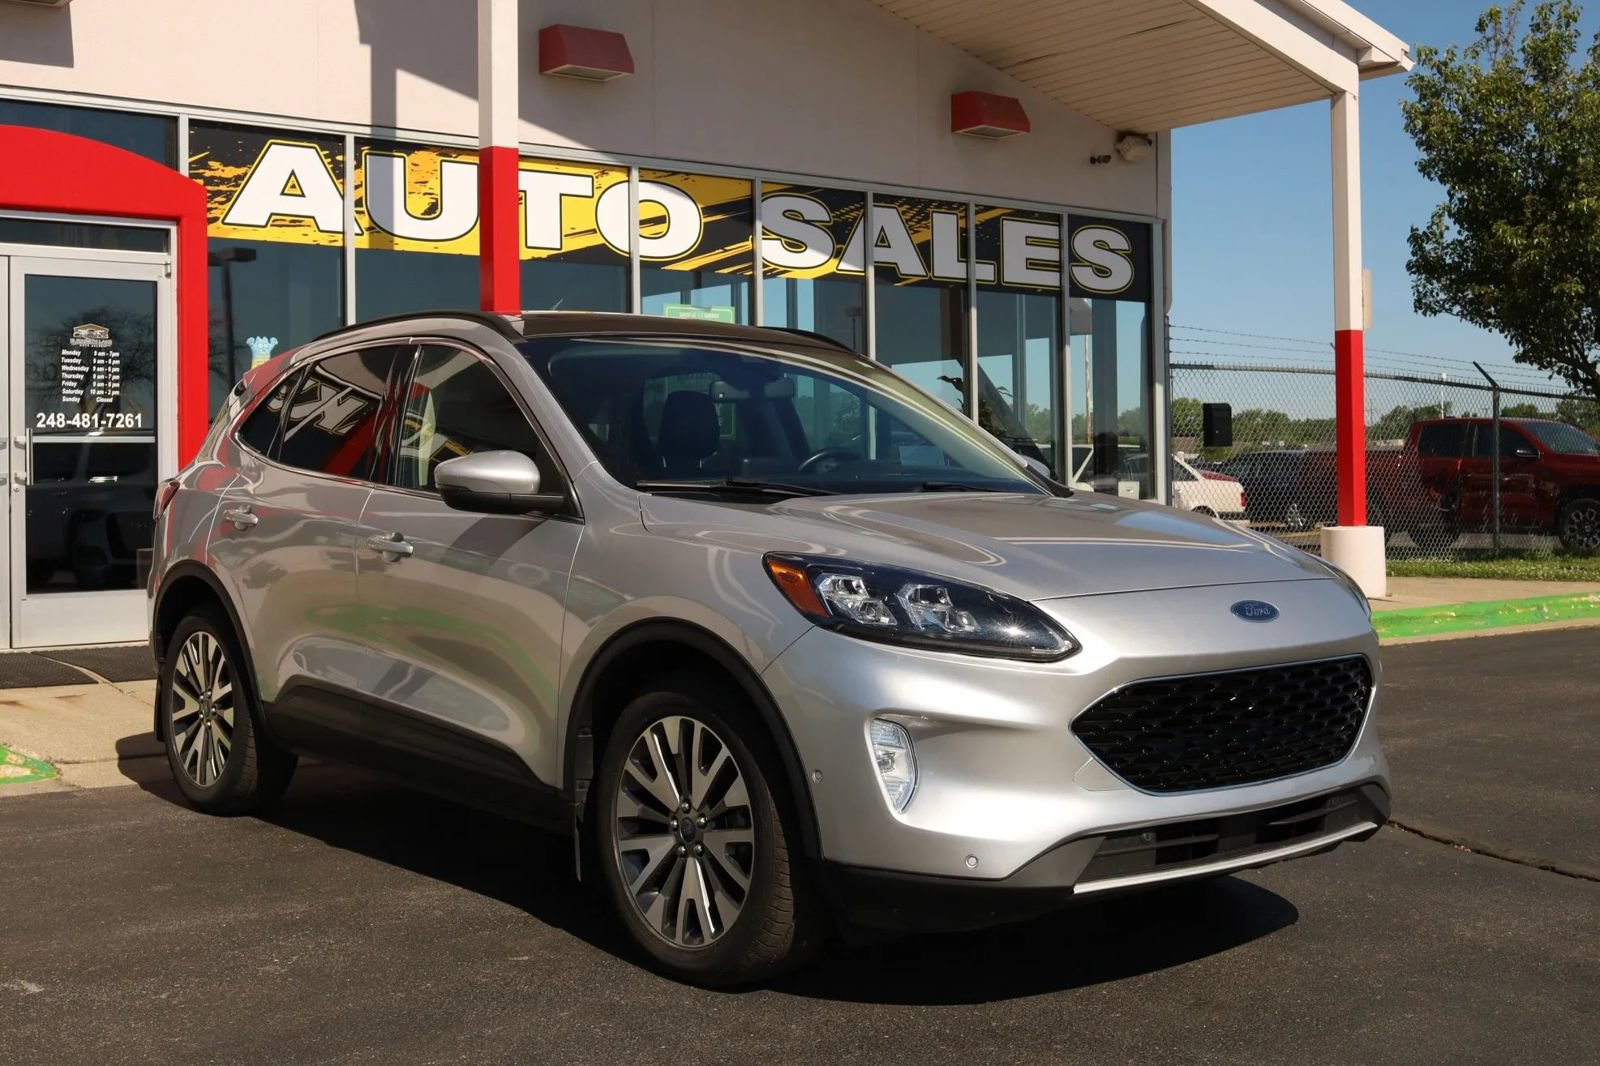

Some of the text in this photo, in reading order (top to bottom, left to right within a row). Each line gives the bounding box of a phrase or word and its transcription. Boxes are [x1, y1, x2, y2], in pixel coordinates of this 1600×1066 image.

[221, 140, 1134, 292] AUTO SALES
[61, 349, 81, 357] Monday
[61, 356, 82, 365] Tuesday
[61, 365, 89, 373] Wednesday
[61, 372, 84, 381] Thursday
[61, 380, 78, 388] Friday
[62, 388, 84, 396] Saturday
[62, 396, 81, 404] Sunday
[36, 412, 142, 428] 248-481-7261
[1244, 603, 1271, 616] Ford
